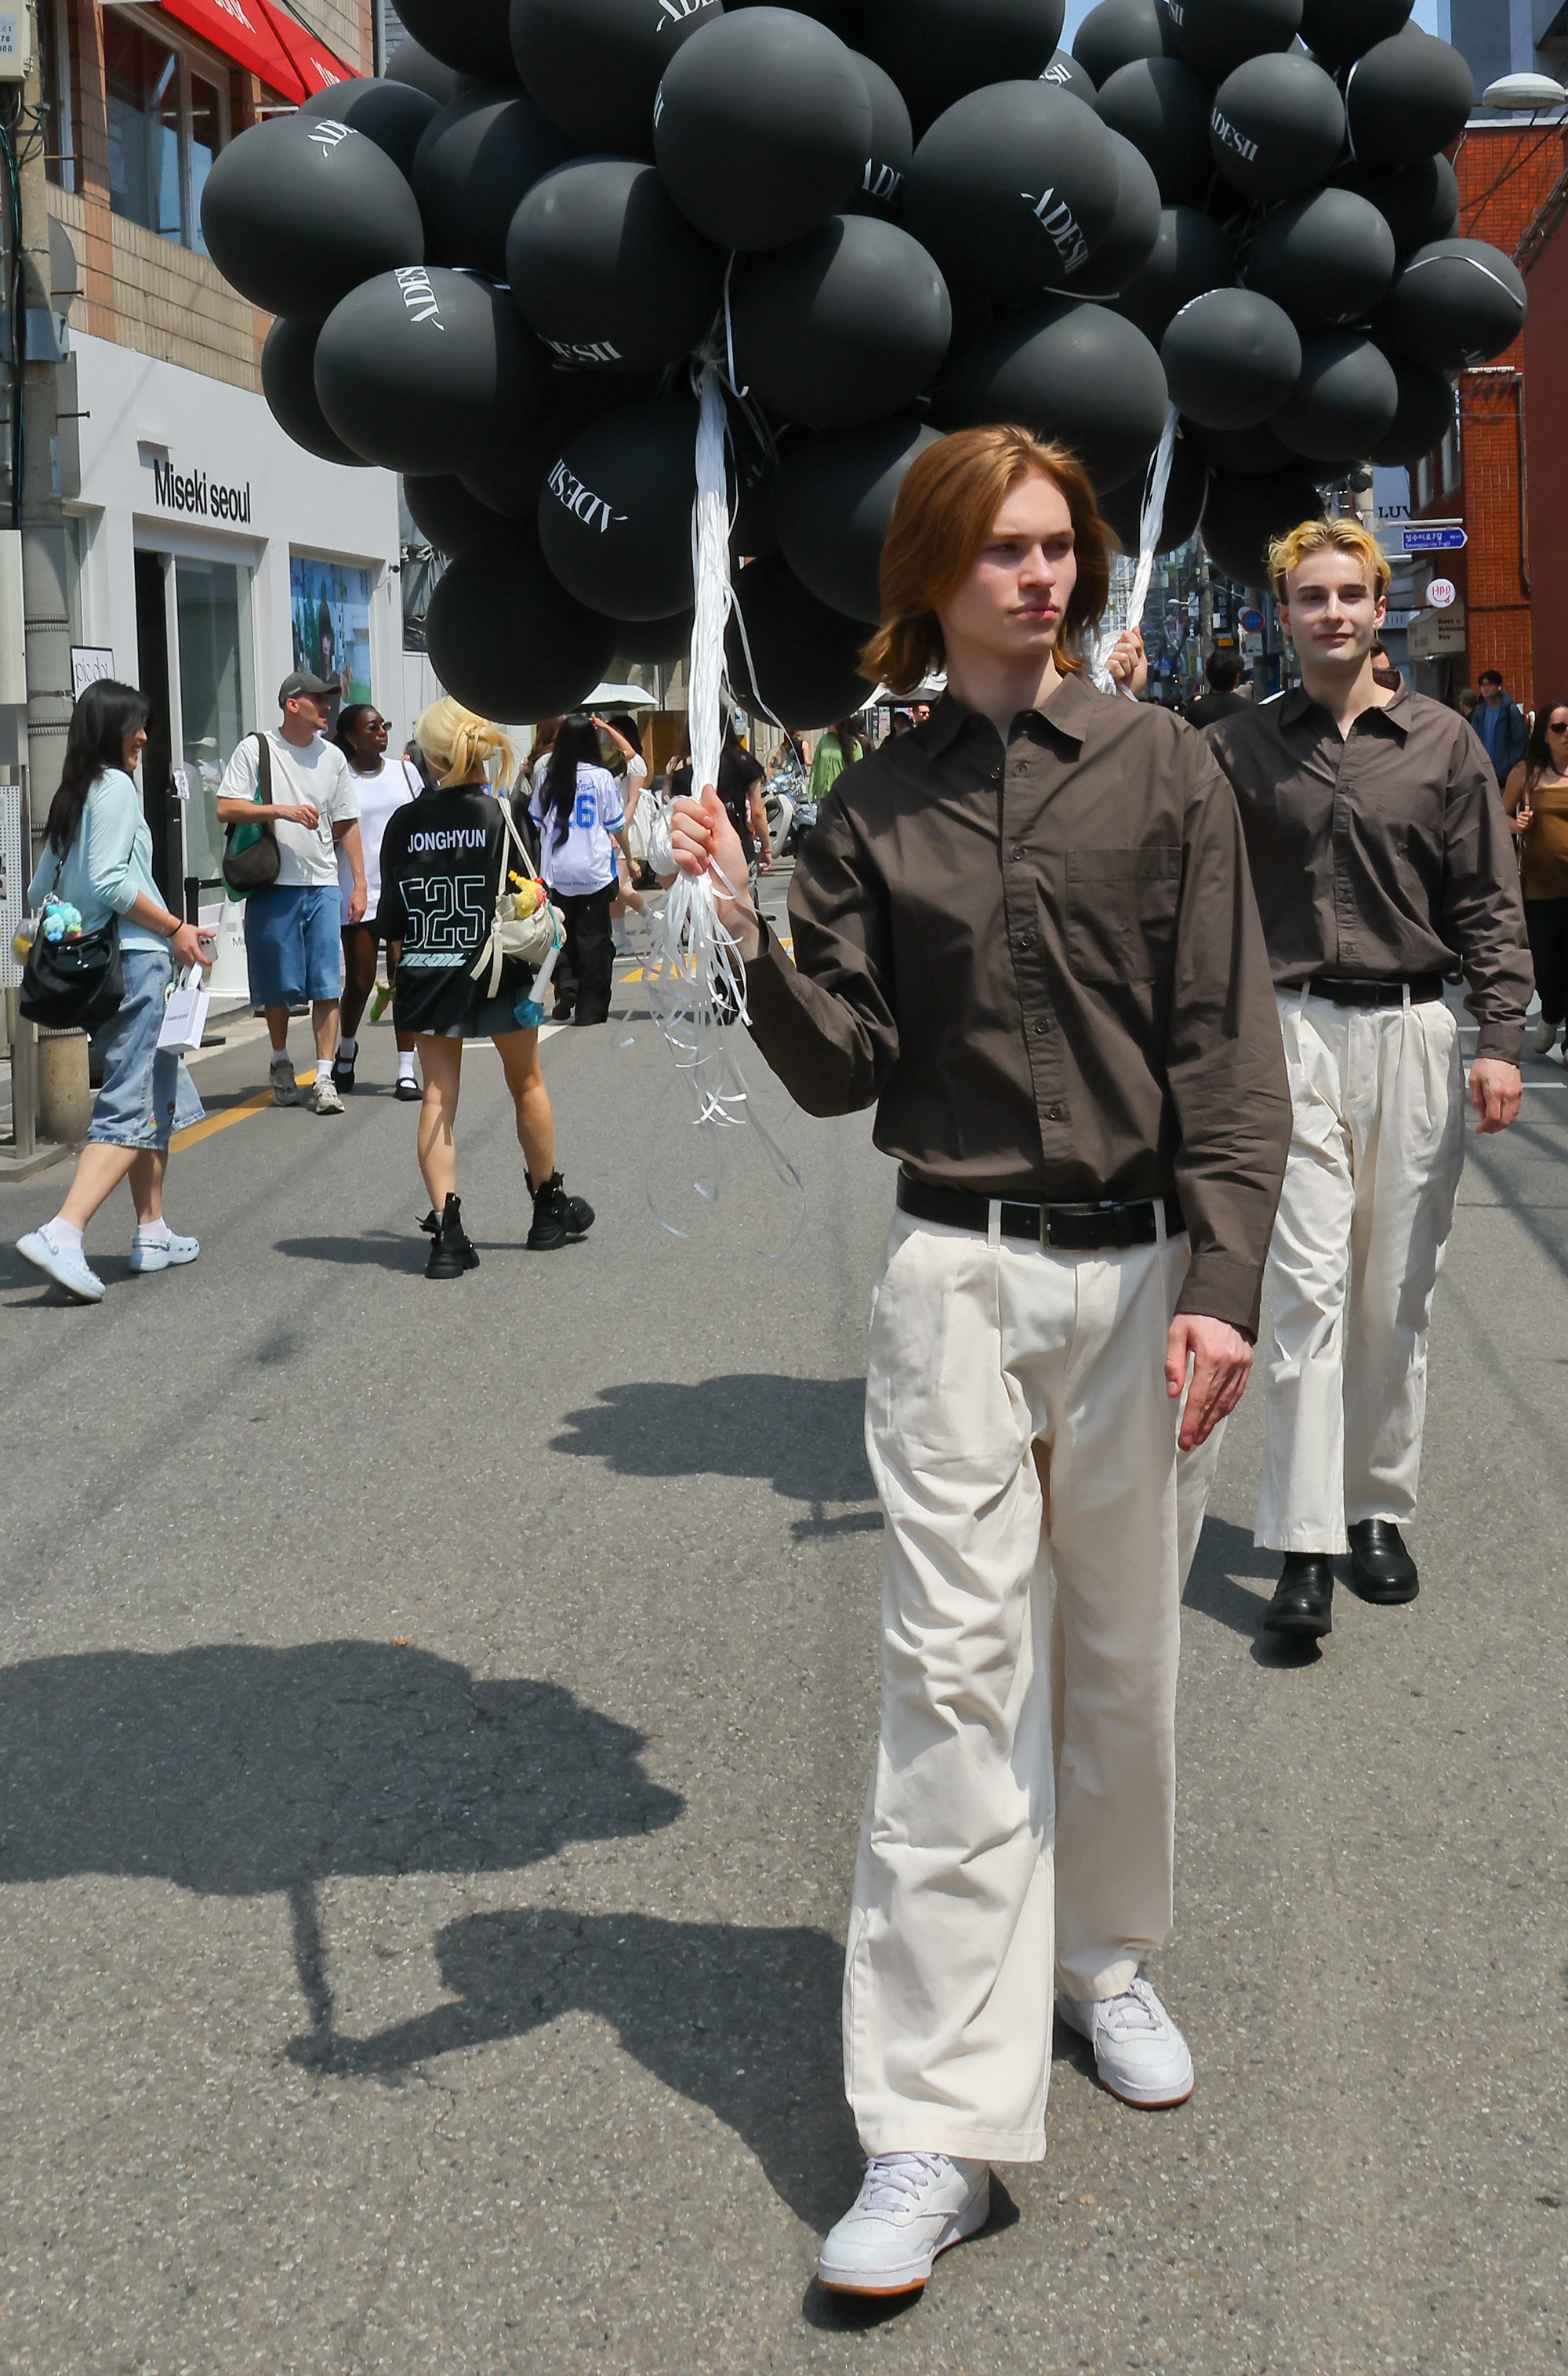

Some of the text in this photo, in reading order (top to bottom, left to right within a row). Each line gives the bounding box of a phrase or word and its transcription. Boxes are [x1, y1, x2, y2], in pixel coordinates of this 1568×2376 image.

[154, 458, 251, 525] Miseki seoul
[407, 828, 487, 854] JONGHYUN
